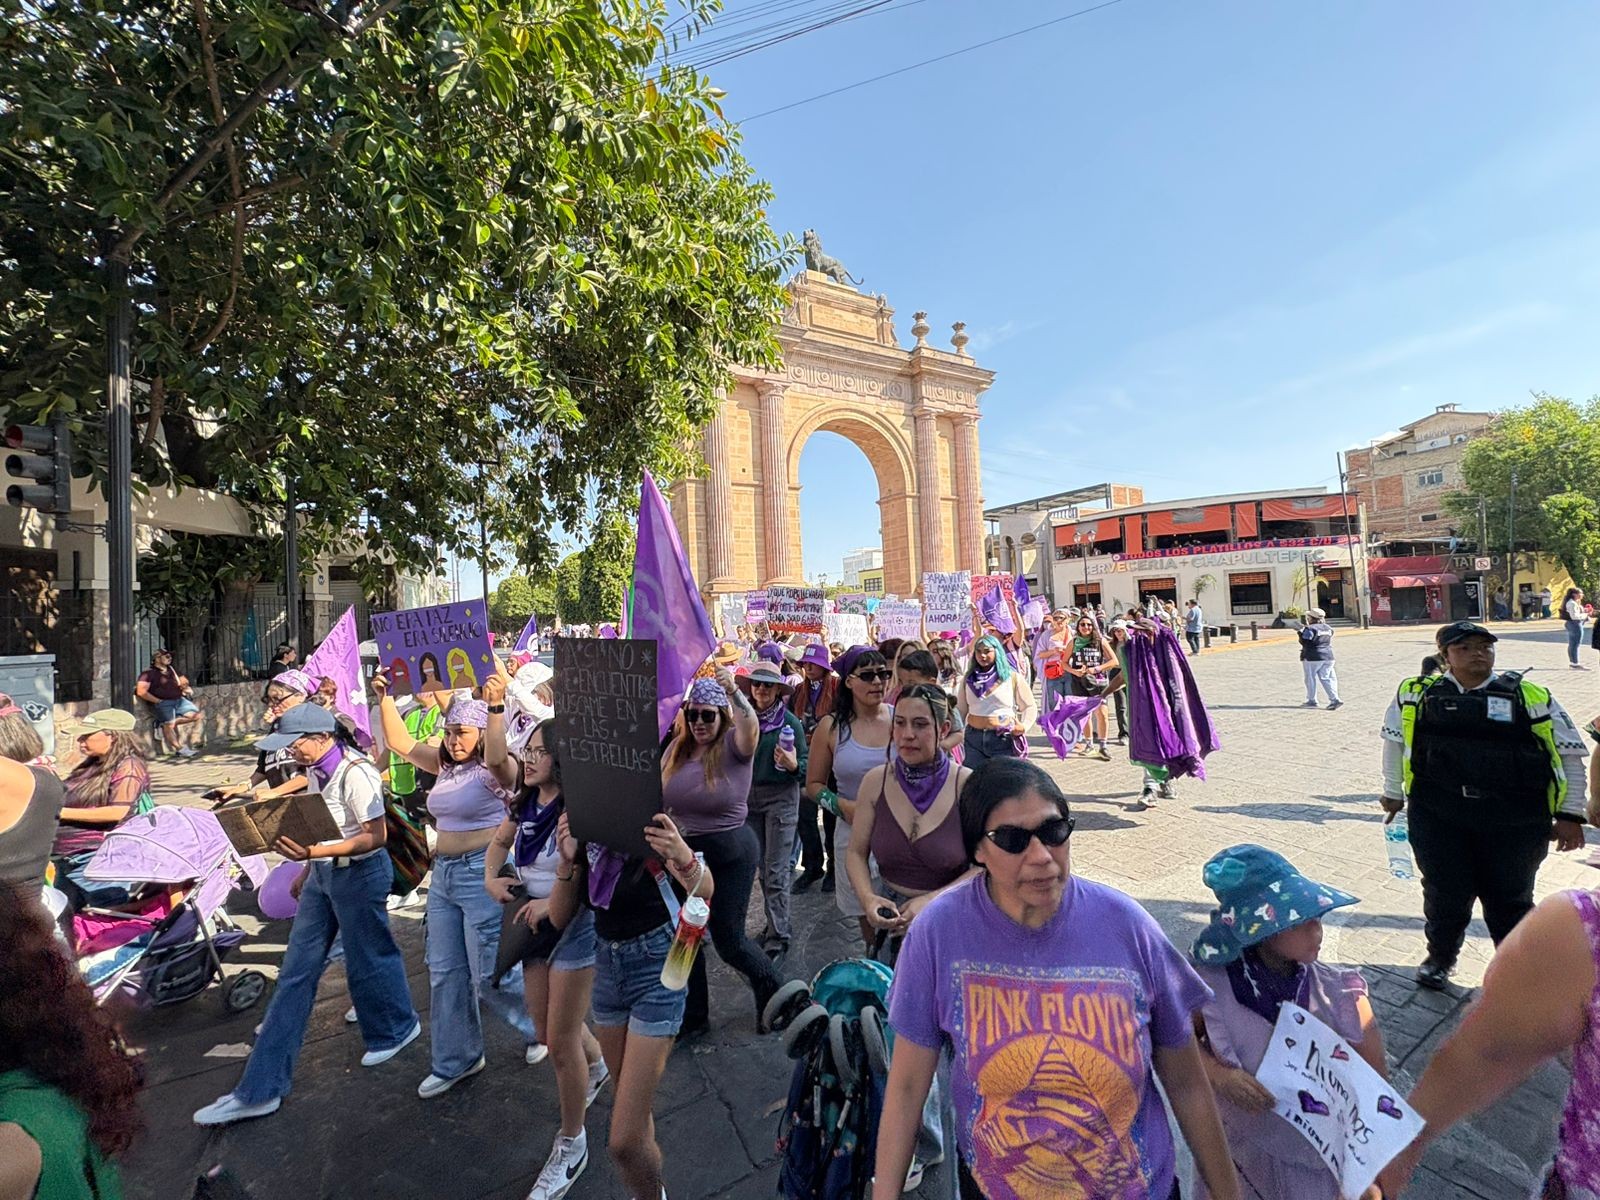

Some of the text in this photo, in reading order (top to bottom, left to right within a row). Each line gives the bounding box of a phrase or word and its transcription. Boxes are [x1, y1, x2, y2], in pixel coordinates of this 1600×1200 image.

[1124, 550, 1161, 560] TODOS
[1166, 547, 1189, 557] LOS
[1191, 549, 1325, 568] CHAPULTEPEC
[1453, 556, 1500, 569] TATO
[372, 606, 453, 633] NO ERA PAZ
[404, 620, 482, 647] ERA SILENCIO
[608, 642, 634, 670] NO
[616, 698, 637, 722] EN
[583, 716, 610, 739] LAS
[569, 737, 651, 772] ESTRELLAS
[968, 983, 1136, 1068] PINK FLOYD
